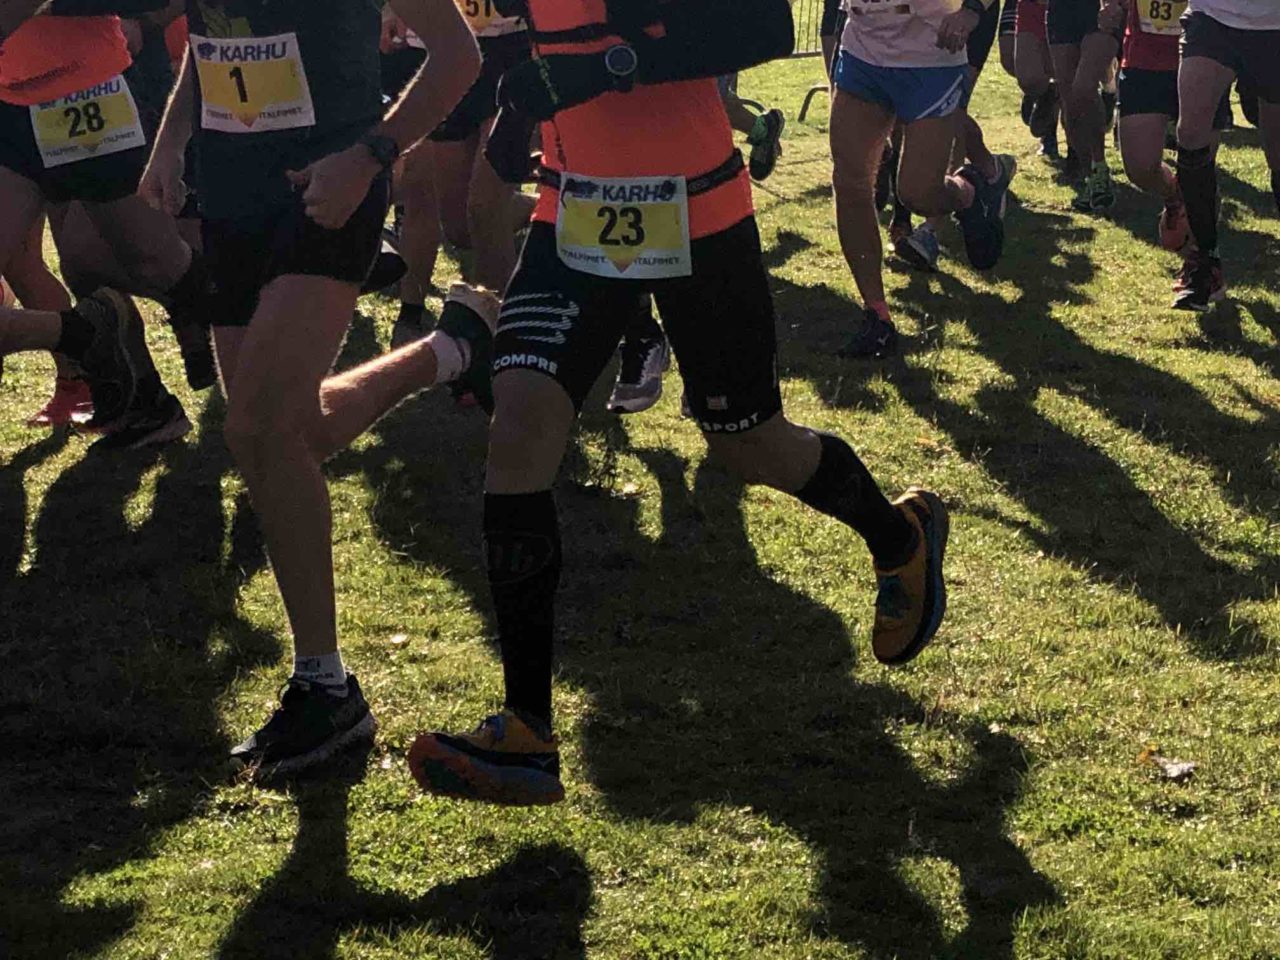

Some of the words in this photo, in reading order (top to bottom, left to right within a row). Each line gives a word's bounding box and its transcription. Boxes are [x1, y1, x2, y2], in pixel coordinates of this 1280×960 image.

[1149, 0, 1173, 22] 83
[220, 42, 287, 61] KARHU
[229, 66, 249, 103] 1
[64, 102, 105, 139] 28
[597, 206, 645, 247] 23
[493, 353, 558, 376] COMPRE
